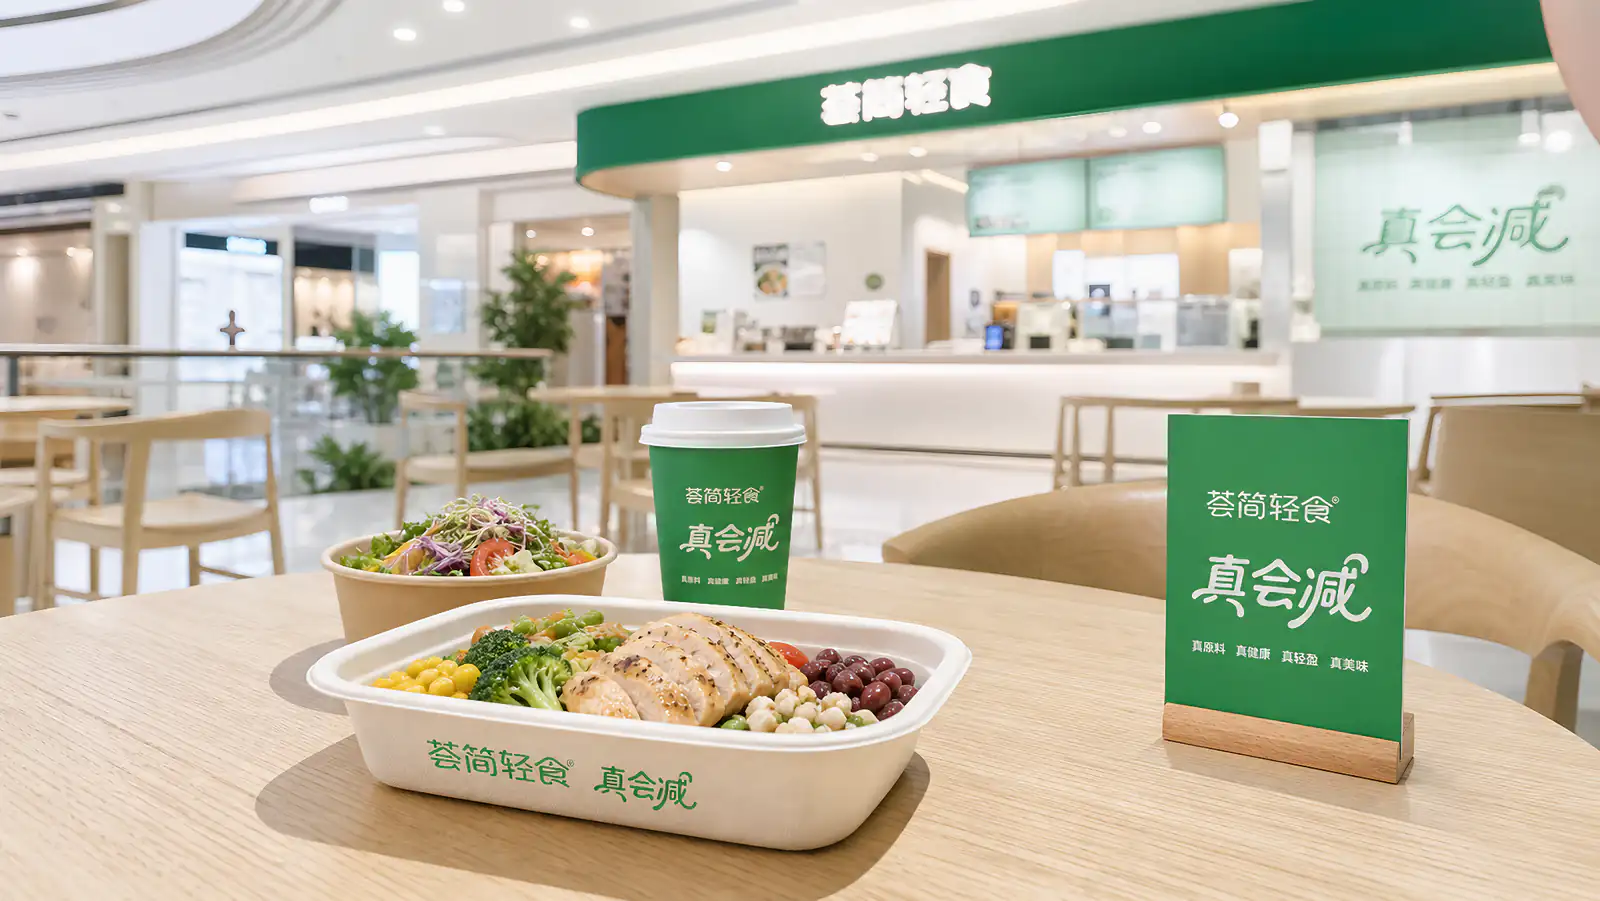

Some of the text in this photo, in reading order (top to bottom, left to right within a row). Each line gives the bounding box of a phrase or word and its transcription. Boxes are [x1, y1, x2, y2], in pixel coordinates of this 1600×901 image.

[1361, 184, 1569, 267] 真会减
[1206, 489, 1334, 524] 荟简轻食
[679, 513, 780, 562] 真会减
[1191, 553, 1372, 629] 真会减
[1192, 640, 1369, 673] 真原料 真健康 真轻盈 真美味
[594, 765, 697, 811] 真会减
